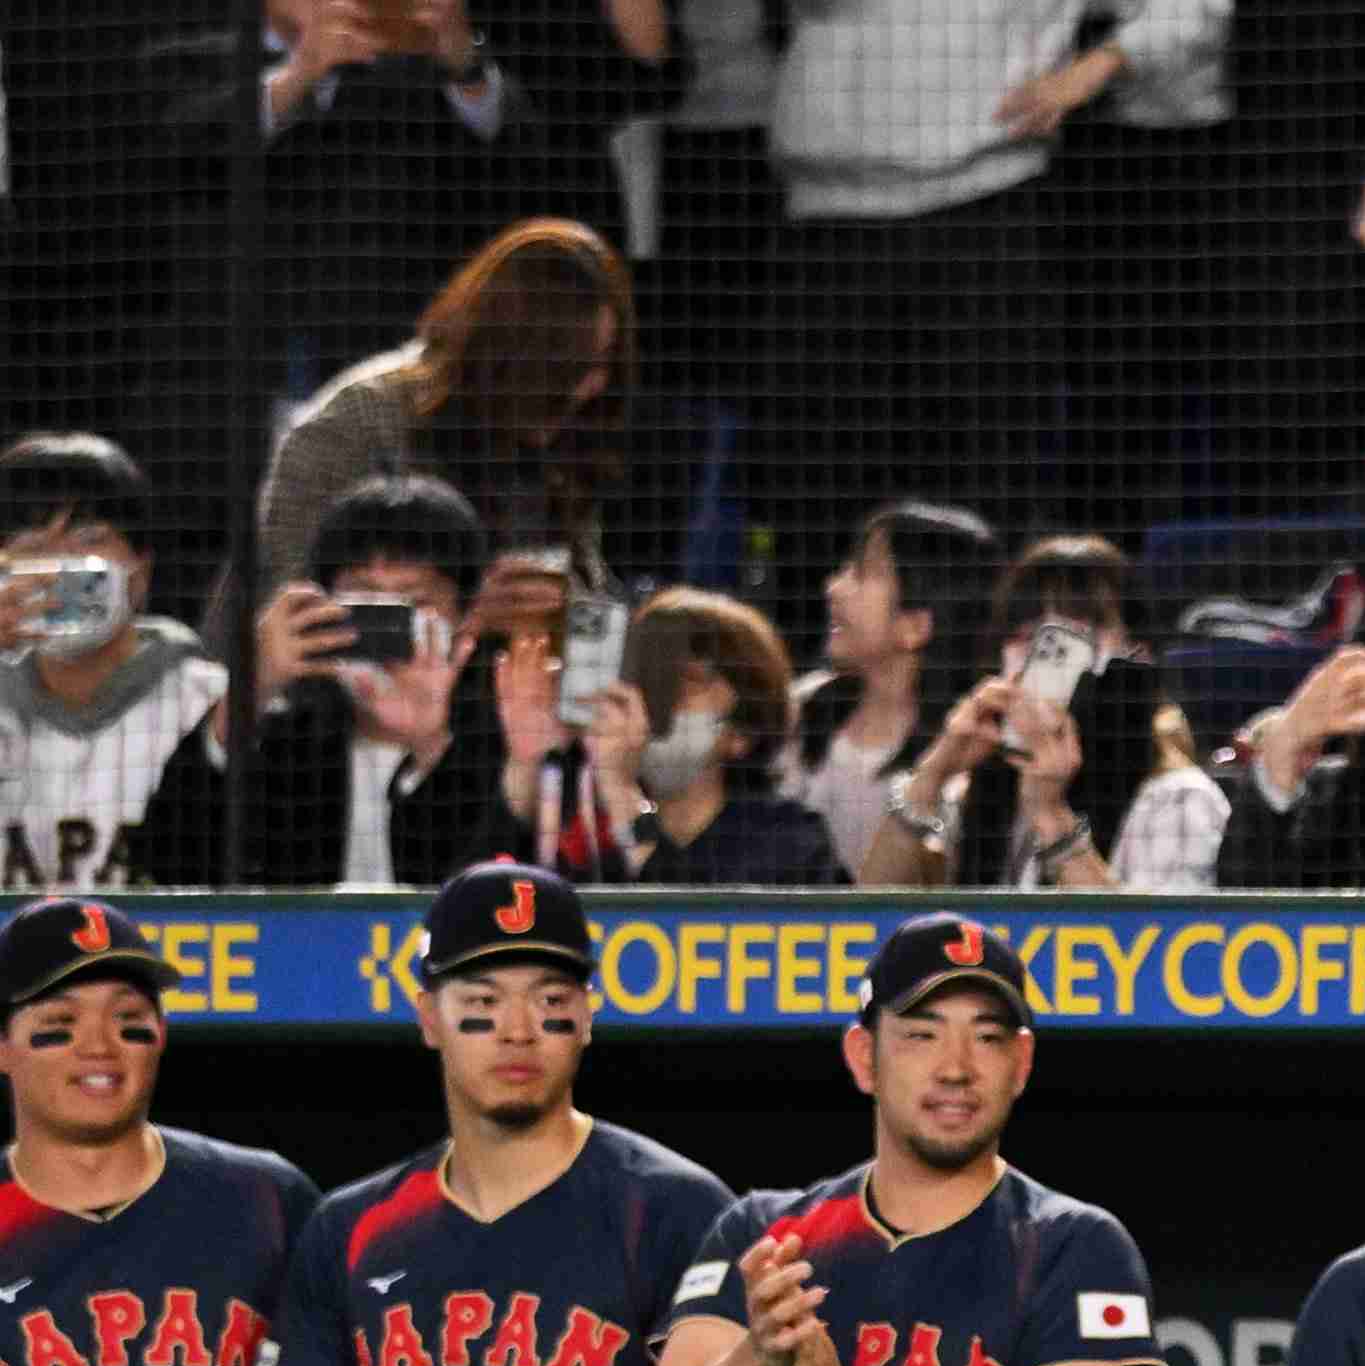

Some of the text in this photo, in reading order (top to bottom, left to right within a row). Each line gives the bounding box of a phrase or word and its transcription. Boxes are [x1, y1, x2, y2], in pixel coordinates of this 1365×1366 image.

[72, 904, 110, 951] J
[496, 881, 537, 934] J
[944, 922, 985, 966] J
